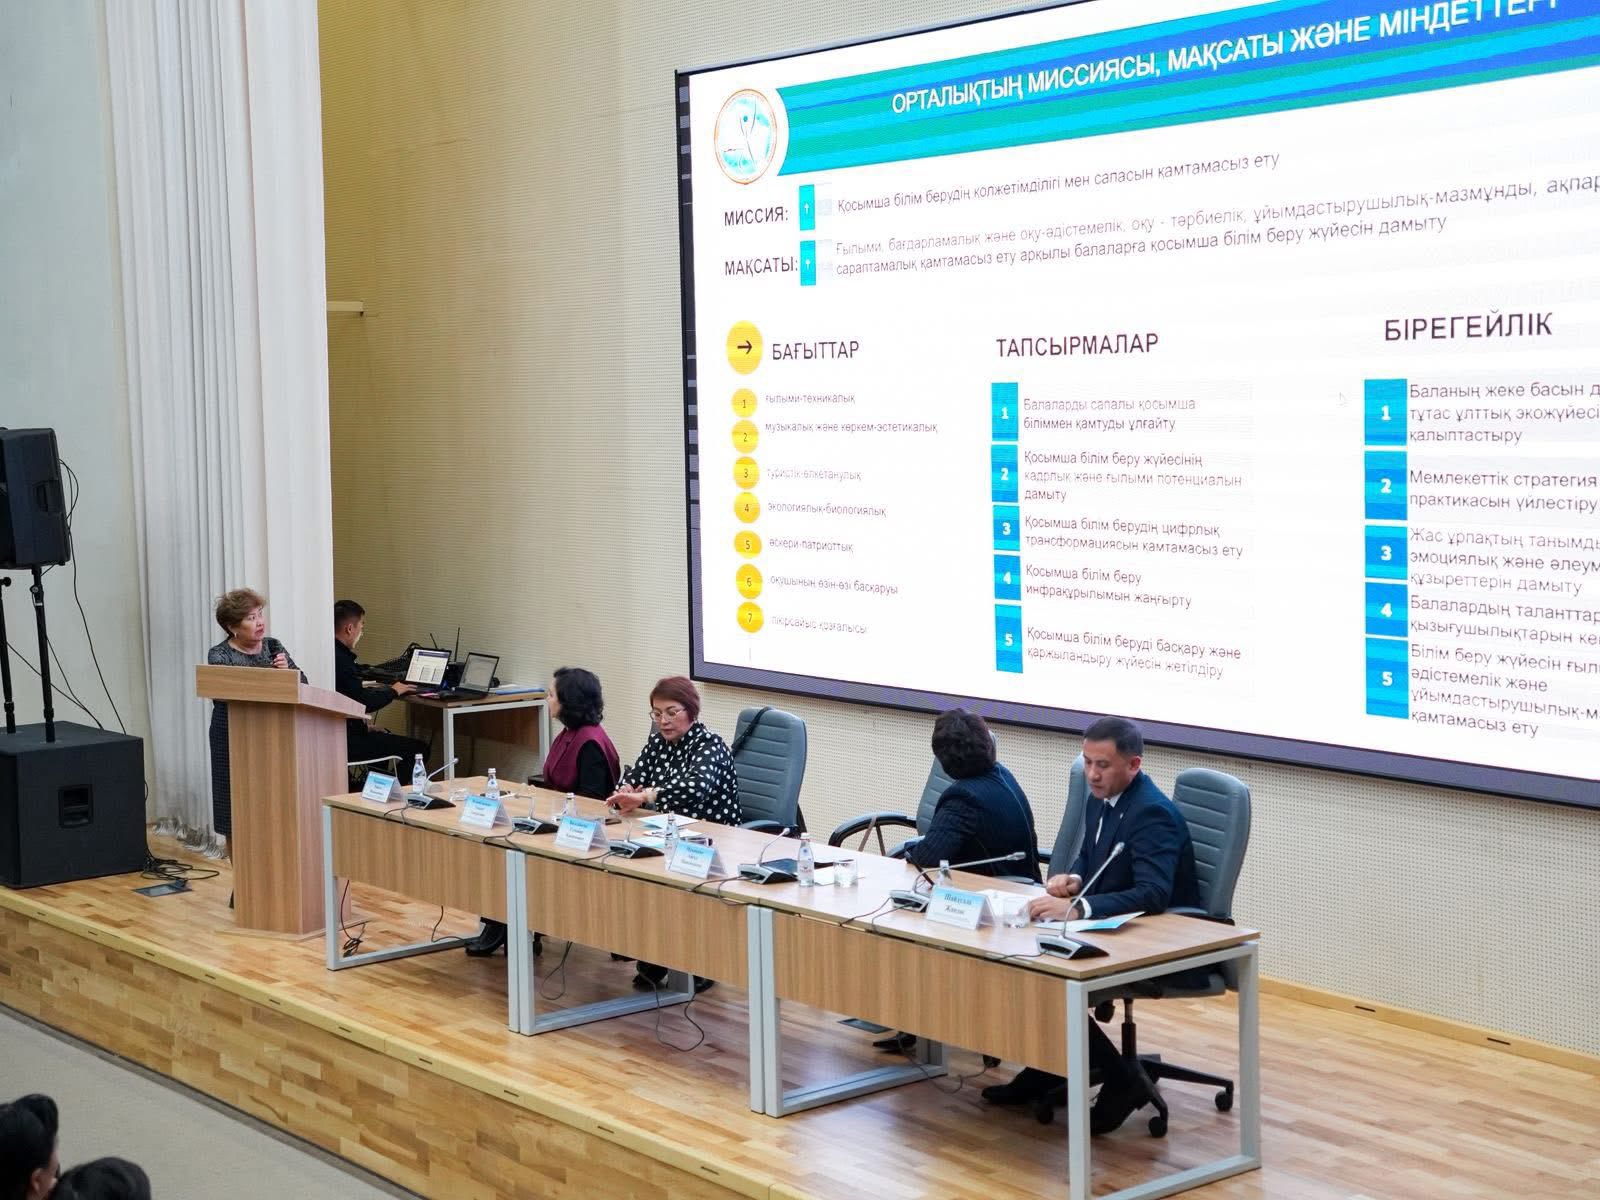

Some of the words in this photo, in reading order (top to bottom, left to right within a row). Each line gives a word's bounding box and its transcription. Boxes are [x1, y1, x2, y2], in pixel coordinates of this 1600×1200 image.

[892, 73, 1024, 113] ОРТАЛЫҚТЫҢ
[1028, 54, 1160, 91] МИССИЯСЫ,
[1168, 31, 1284, 71] МАҚСАТЫ
[1291, 15, 1370, 53] ЖӘНЕ
[838, 195, 890, 213] Қосымша
[893, 191, 922, 207] білім
[926, 186, 970, 205] берудің
[974, 176, 1061, 198] қолжетімділігі
[1064, 176, 1090, 189] мен
[1094, 167, 1153, 185] сапасын
[1158, 156, 1249, 180] қамтамасыз
[1253, 153, 1280, 170] ету
[724, 208, 788, 227] МИССИЯ:
[888, 233, 980, 251] бағдарламалық
[985, 230, 1016, 243] және
[1132, 217, 1155, 234] оқу
[1171, 209, 1247, 230] тәрбиелік,
[836, 259, 917, 276] сараптамалық
[920, 252, 993, 270] қамтамасыз
[996, 250, 1016, 267] ету
[1020, 247, 1071, 264] арқылы
[1074, 240, 1146, 258] балаларға
[1150, 235, 1219, 253] қосымша
[1223, 229, 1261, 245] білім
[1266, 226, 1304, 245] беру
[1309, 219, 1374, 241] жүйесін
[1379, 216, 1448, 236] дамыту
[724, 257, 798, 278] МАҚСАТЫ:
[1385, 308, 1553, 341] БІРЕГЕЙЛІК
[772, 340, 860, 361] БАҒЫТТАР
[996, 333, 1159, 357] ТАПСЫРМАЛАР
[1410, 384, 1480, 400] Баланың
[1485, 385, 1525, 397] жеке
[1530, 382, 1584, 397] басын
[741, 399, 747, 409] 1
[1001, 407, 1009, 419] 1
[1023, 398, 1088, 411] Балаларды
[1091, 400, 1135, 409] сапалы
[1138, 399, 1196, 411] қосымша
[1381, 405, 1391, 420] 1
[1410, 408, 1451, 422] тұтас
[1456, 408, 1512, 422] ұлттық
[816, 423, 839, 432] және
[1023, 417, 1073, 430] біліммен
[1075, 419, 1124, 432] қамтуды
[1129, 418, 1176, 432] ұлғайту
[743, 432, 748, 442] 2
[1410, 429, 1522, 445] қалыптастыру
[1024, 450, 1077, 466] Қосымша
[1080, 452, 1109, 465] білім
[1112, 452, 1141, 467] беру
[1143, 453, 1203, 468] жүйесінің
[743, 468, 749, 478] 3
[1001, 468, 1009, 480] 2
[1074, 472, 1103, 483] және
[1106, 473, 1153, 484] ғылыми
[1157, 474, 1242, 487] потенциалын
[1410, 470, 1509, 486] Мемлекеттік
[1513, 475, 1597, 489] стратегия
[1380, 478, 1392, 493] 2
[1024, 490, 1067, 503] дамыту
[1410, 493, 1510, 508] практикасын
[1516, 494, 1598, 514] үйлестіру
[744, 503, 750, 513] 4
[1002, 522, 1011, 535] 3
[1025, 515, 1078, 530] Қосымша
[1080, 518, 1109, 531] білім
[1112, 519, 1158, 535] берудің
[1162, 522, 1220, 538] цифрлық
[745, 540, 751, 550] 5
[1410, 528, 1443, 542] Жас
[1448, 532, 1524, 548] ұрпақтың
[1025, 536, 1139, 551] трансформациясын
[1222, 545, 1243, 560] ету
[1380, 546, 1392, 561] 3
[1410, 551, 1498, 567] эмоциялық
[1502, 556, 1544, 569] және
[746, 577, 752, 587] 6
[1003, 572, 1011, 584] 4
[1026, 564, 1078, 579] Қосымша
[1082, 567, 1111, 581] білім
[1113, 570, 1142, 586] беру
[1410, 573, 1512, 590] құзыреттерін
[1517, 580, 1582, 597] дамыту
[1026, 585, 1130, 601] инфрақұрылымын
[1134, 592, 1192, 609] жаңғырту
[1410, 595, 1510, 616] Балалардың
[747, 613, 753, 623] 7
[1380, 603, 1393, 617] 4
[1005, 633, 1013, 646] 5
[1410, 619, 1572, 643] қызығушылықтарын
[1580, 633, 1600, 646] ке
[1027, 626, 1080, 643] Қосымша
[1083, 632, 1112, 646] білім
[1115, 635, 1153, 651] беруді
[1156, 639, 1205, 658] басқару
[1209, 647, 1242, 660] және
[1027, 648, 1111, 667] қаржыландыру
[1116, 655, 1161, 670] жүйесін
[1165, 663, 1224, 680] жетілдіру
[1410, 644, 1449, 660] Білім
[1455, 648, 1492, 665] беру
[1497, 654, 1561, 670] жүйесін
[1567, 661, 1600, 674] ғыл
[1382, 671, 1393, 686] 5
[1411, 668, 1502, 688] әдістемелік
[1506, 679, 1548, 692] және
[1411, 688, 1600, 720] ұйымдастырушылық-м
[1411, 711, 1506, 732] қамтамасыз
[1512, 722, 1539, 738] ету
